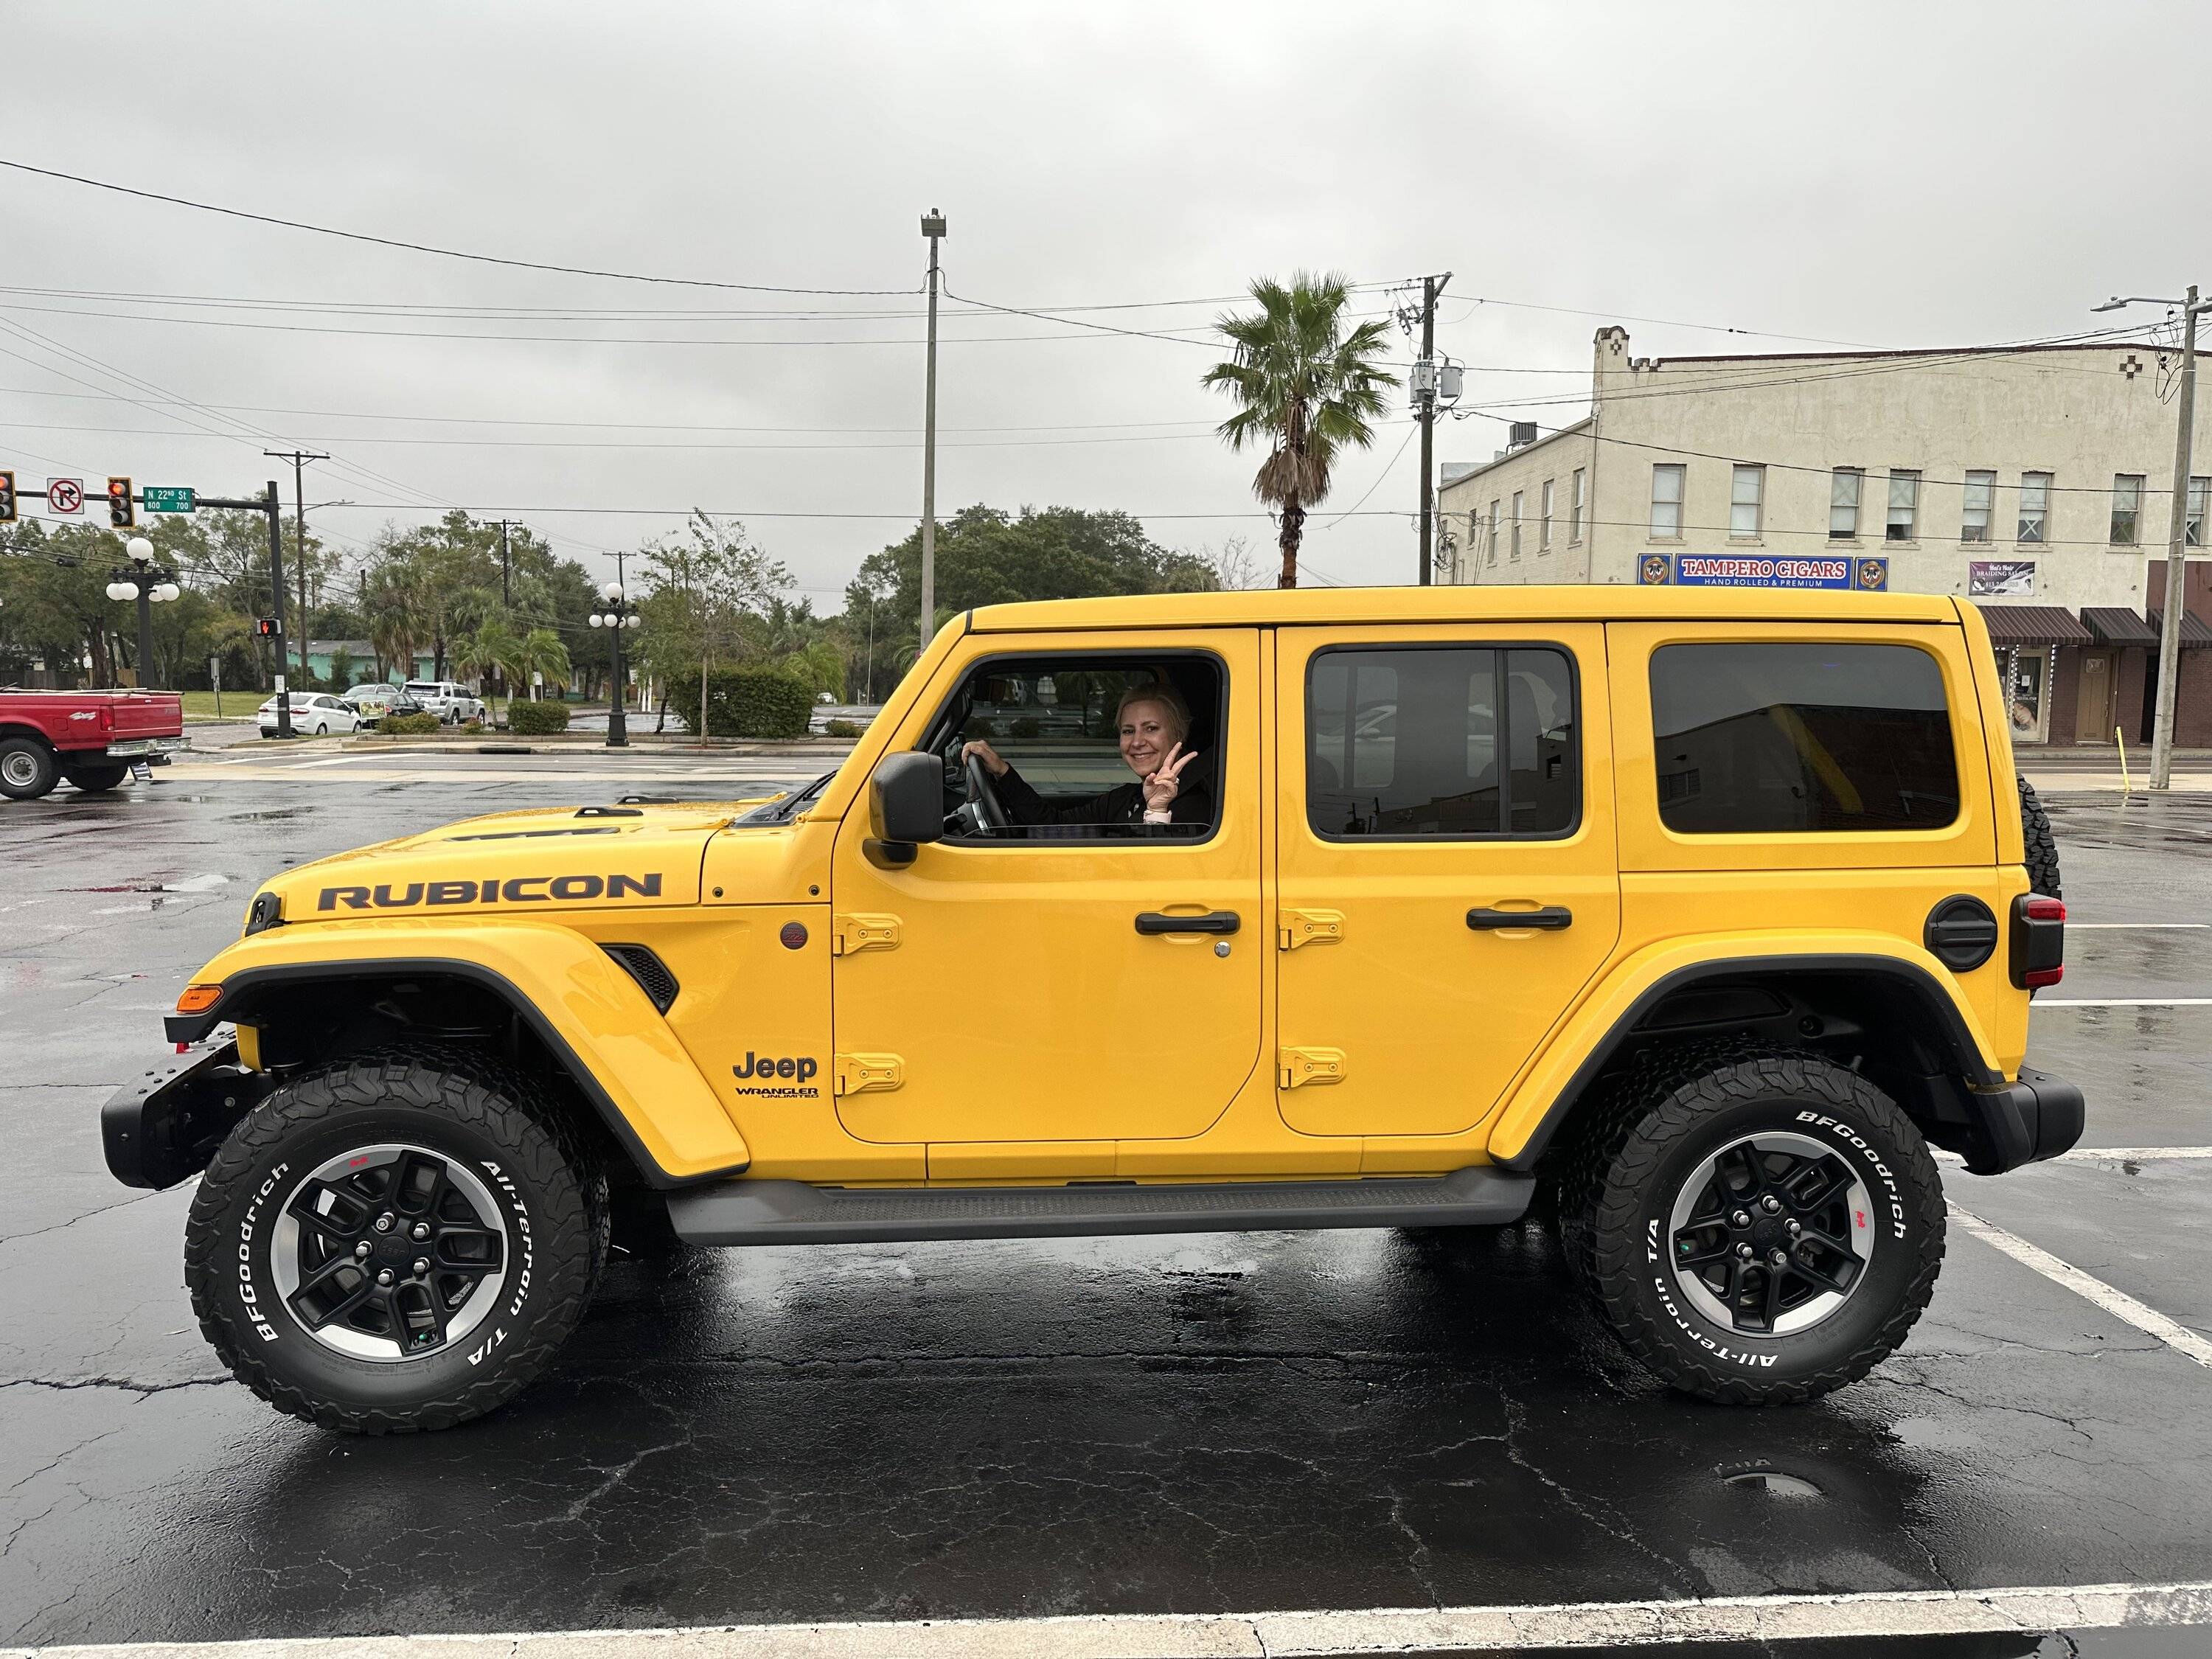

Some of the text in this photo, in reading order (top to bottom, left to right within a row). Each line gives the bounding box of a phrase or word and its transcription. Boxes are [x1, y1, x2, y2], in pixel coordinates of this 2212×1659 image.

[147, 490, 187, 500] N 22ND St
[1682, 559, 1846, 579] TAMPERO CIGARS
[317, 873, 663, 911] RUBICON
[732, 1051, 818, 1083] Jeep
[1795, 1110, 1906, 1239] BFGoodrich
[238, 1162, 290, 1343] BFGoodrich
[467, 1161, 532, 1367] All-Terrain T/A
[1646, 1218, 1779, 1368] All-Terrain T/A
